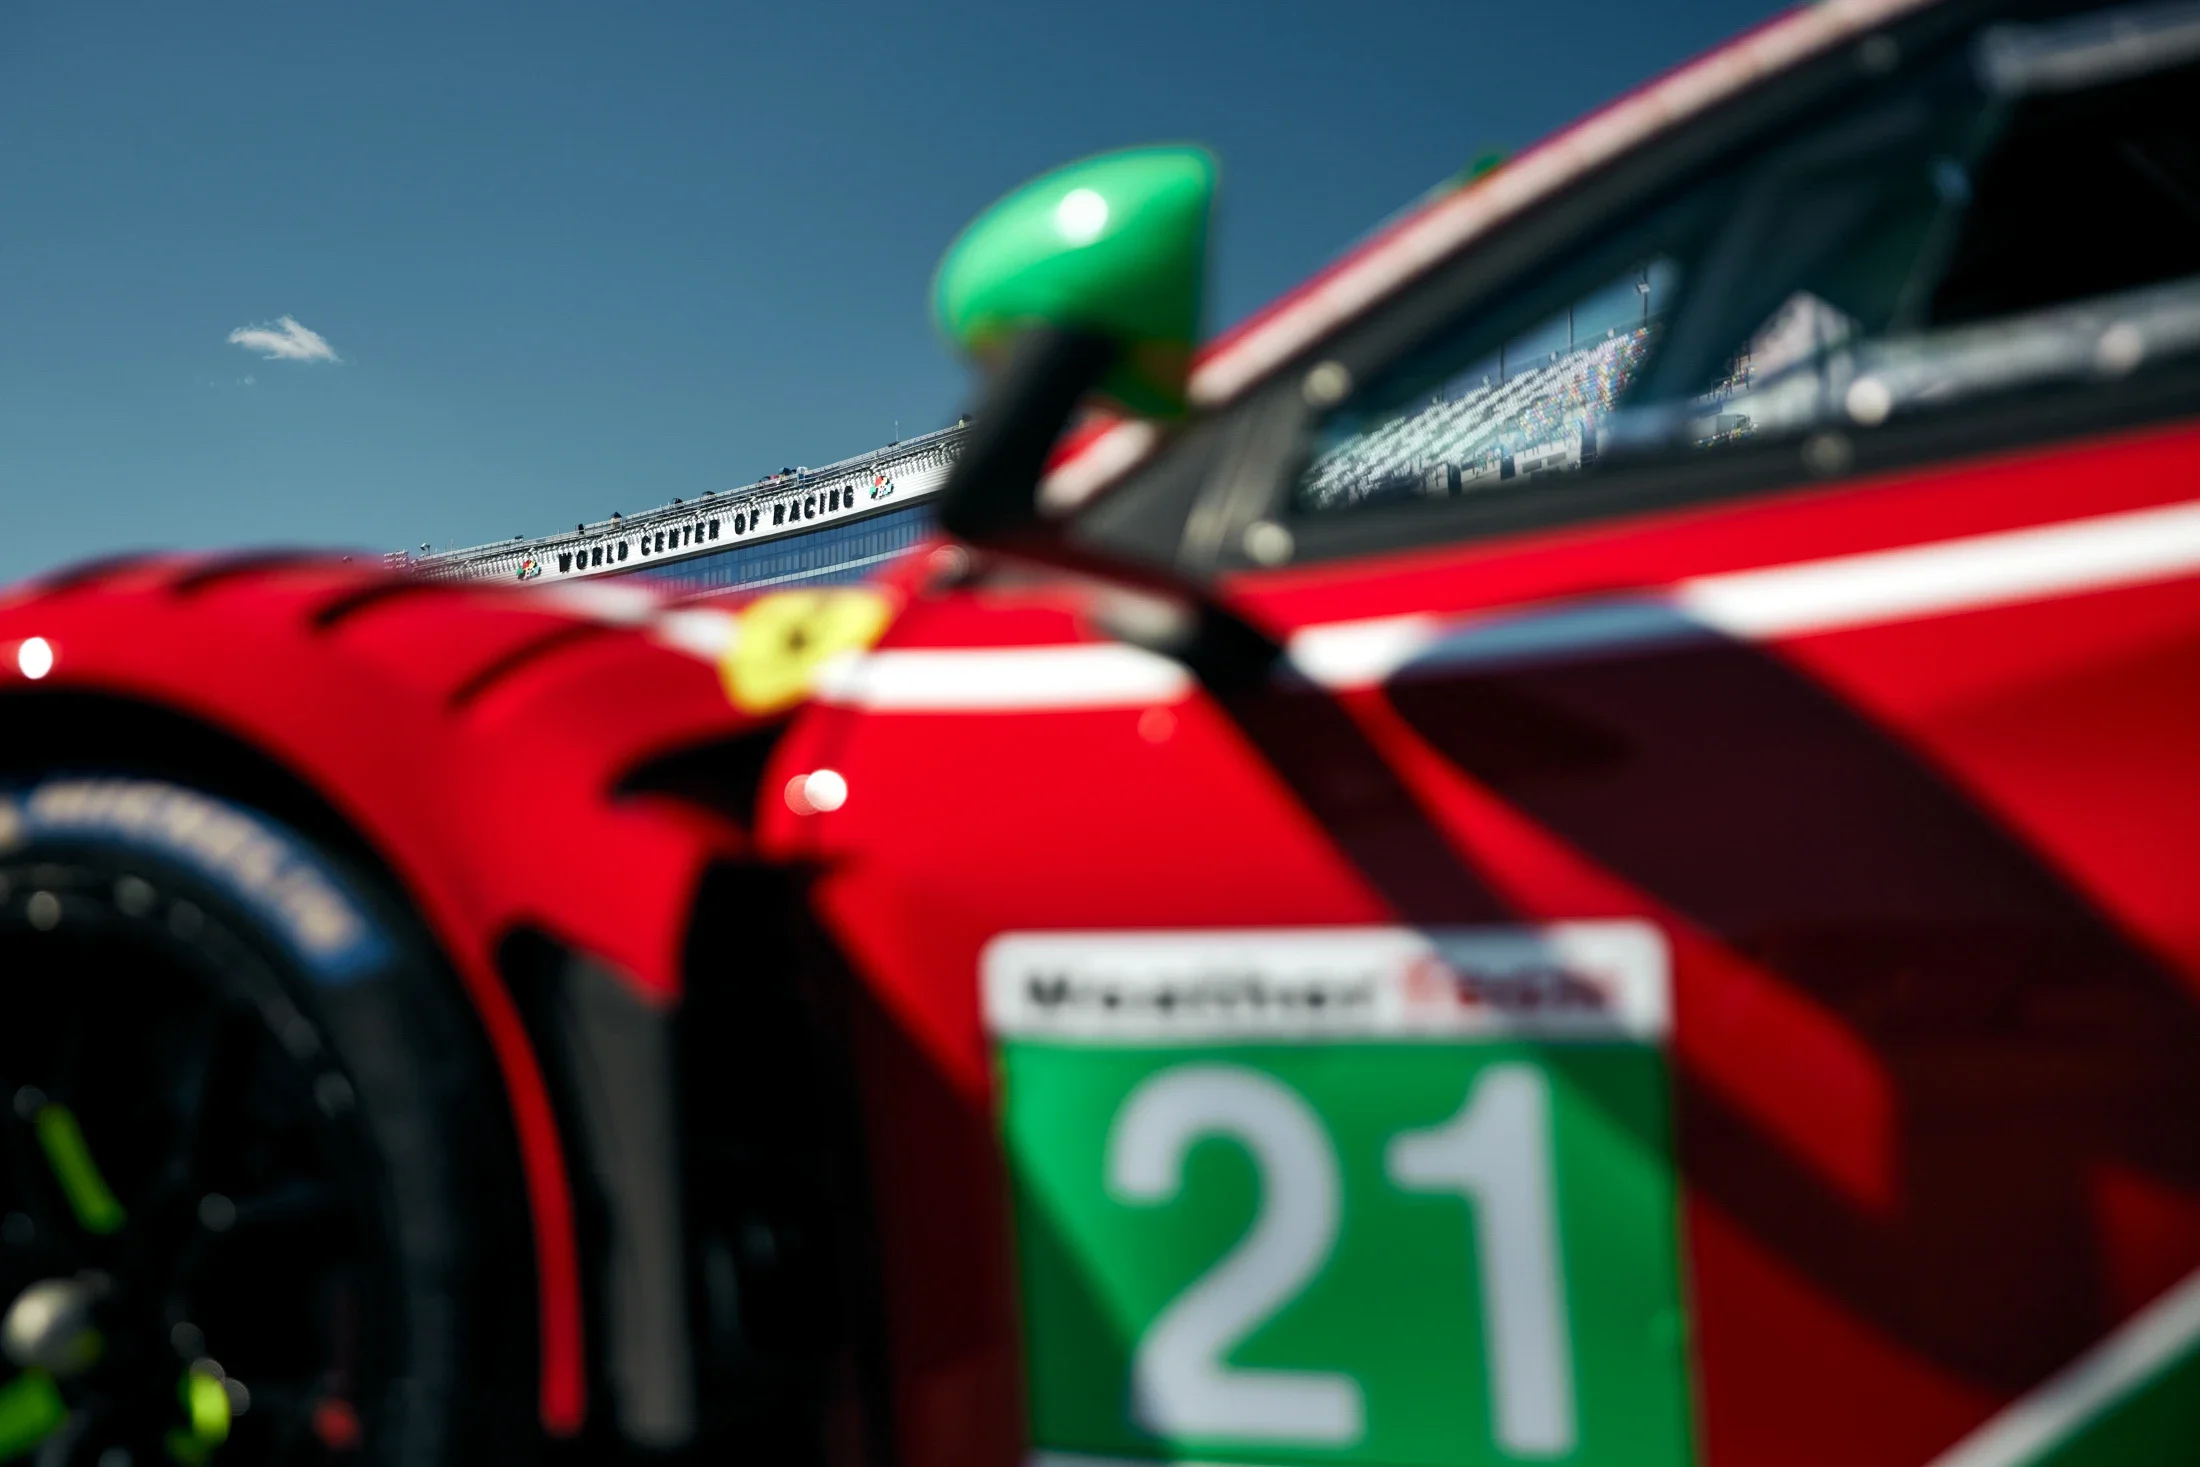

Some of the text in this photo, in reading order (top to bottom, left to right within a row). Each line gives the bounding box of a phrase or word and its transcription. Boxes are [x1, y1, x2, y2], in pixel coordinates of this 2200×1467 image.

[558, 485, 854, 573] WORLD CENTER OF RACING
[1105, 1060, 1577, 1457] 21
